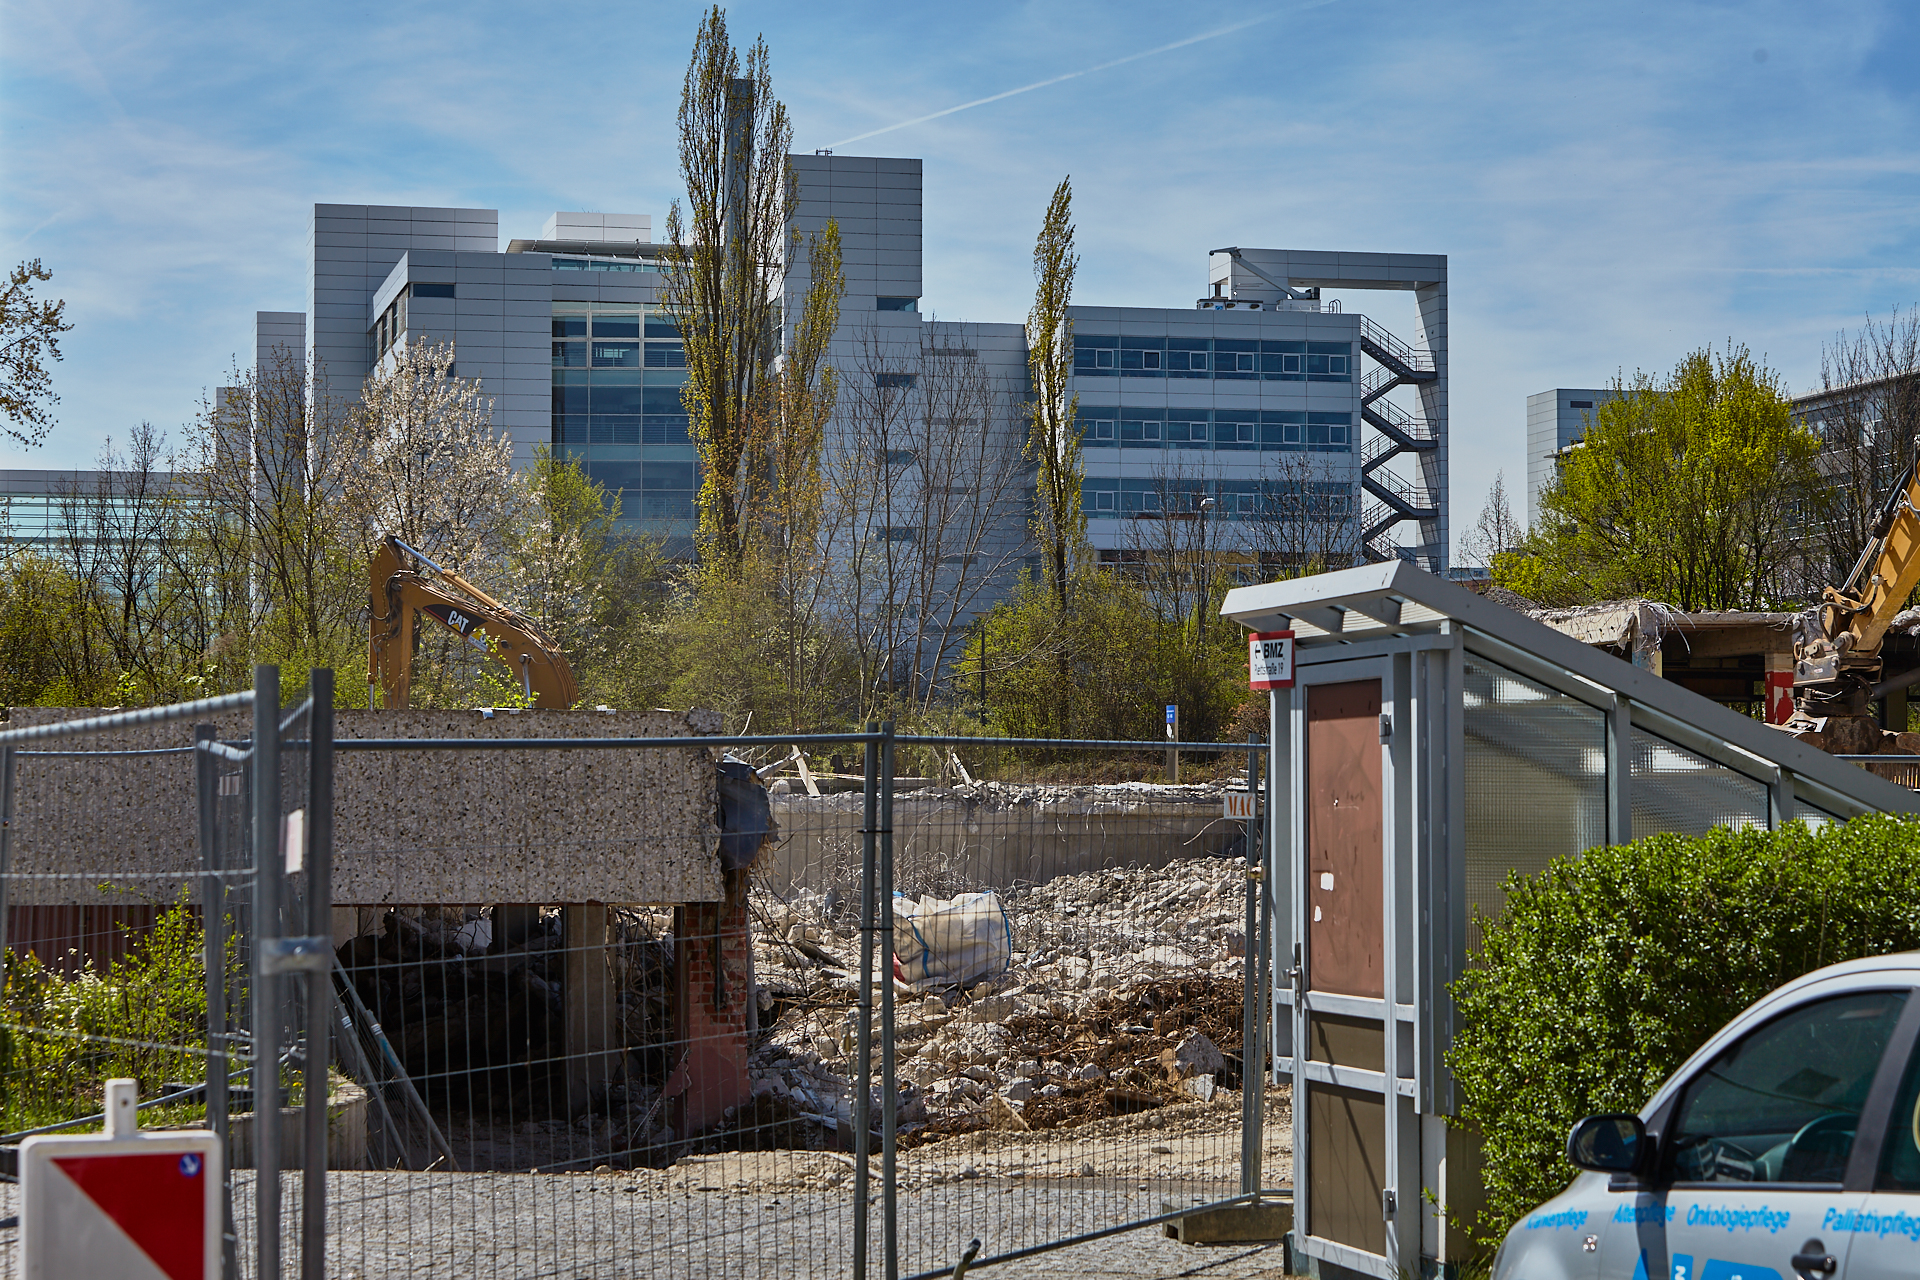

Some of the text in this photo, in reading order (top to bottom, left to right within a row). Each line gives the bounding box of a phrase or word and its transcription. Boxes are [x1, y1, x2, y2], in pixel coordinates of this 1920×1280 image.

[447, 610, 469, 633] CAT
[1263, 642, 1284, 659] BMZ
[1687, 1203, 1790, 1234] Onkologiepflege
